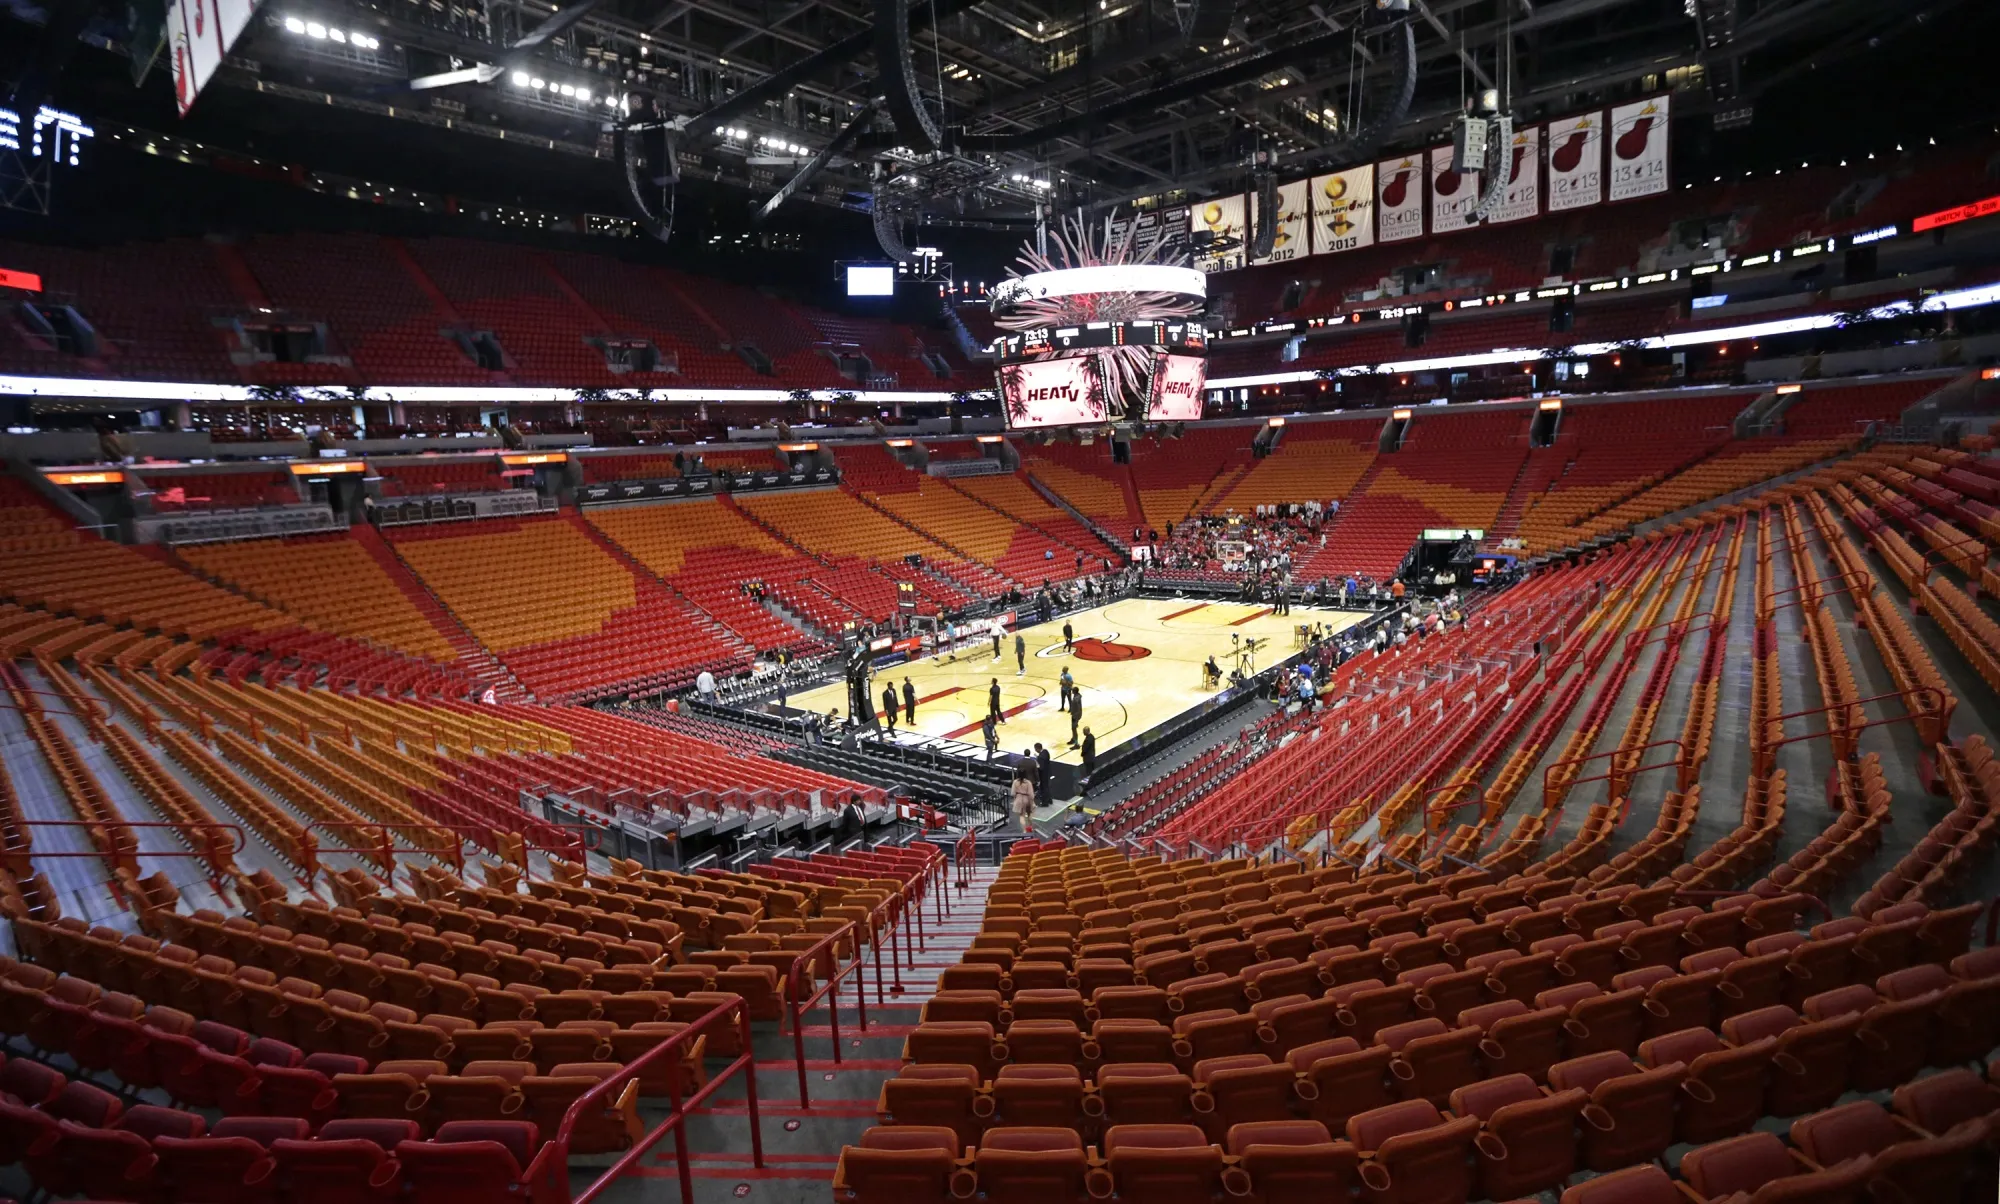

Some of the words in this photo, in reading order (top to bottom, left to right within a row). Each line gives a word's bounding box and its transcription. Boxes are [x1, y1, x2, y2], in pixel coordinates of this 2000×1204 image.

[1615, 166, 1631, 182] 13
[1647, 160, 1663, 176] 14
[1552, 179, 1568, 193] 12
[1583, 172, 1598, 189] 13
[1613, 182, 1665, 198] CHAMPIONS
[1520, 186, 1535, 202] 12
[1552, 194, 1598, 207] CHAMPIONS
[1436, 202, 1451, 217] 10
[1491, 207, 1536, 221] CHAMPIONS
[1381, 213, 1396, 227] 05
[1404, 208, 1420, 222] 06
[1381, 228, 1420, 239] CHAMPIONS
[1329, 236, 1357, 251] 2013
[1268, 248, 1294, 262] 2012
[1205, 261, 1233, 273] 206
[1380, 307, 1404, 319] 73:13
[1024, 328, 1049, 341] 73:13
[1063, 336, 1070, 346] 0
[1099, 361, 1110, 414] MICCOSUKEE.COM
[1144, 360, 1155, 413] MICCOSUKEE.COM
[996, 377, 1008, 423] MICCOSUKEE.COM
[736, 1186, 748, 1195] 25
